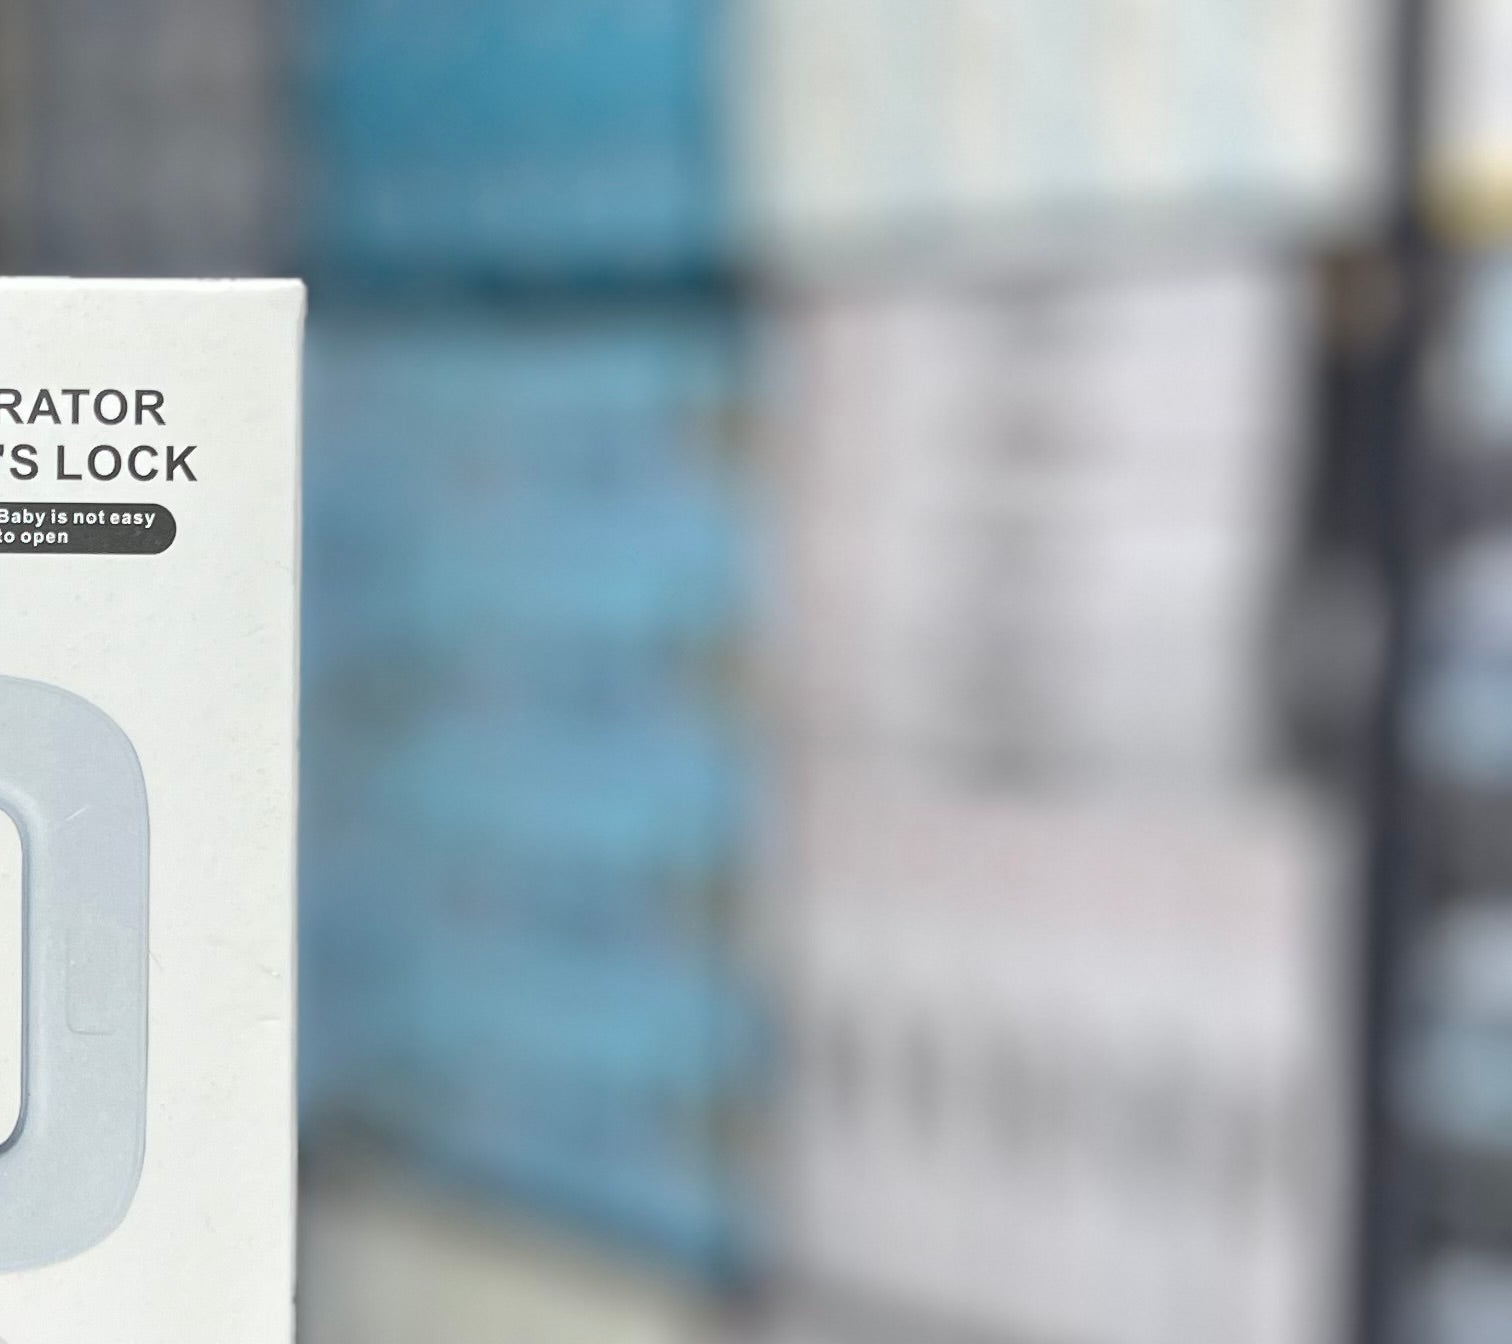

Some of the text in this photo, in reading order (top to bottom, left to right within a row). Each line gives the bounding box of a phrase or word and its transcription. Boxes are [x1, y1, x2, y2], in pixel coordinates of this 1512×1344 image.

[57, 445, 197, 481] LOCK
[50, 509, 68, 525] is
[72, 510, 106, 525] not
[109, 513, 156, 529] easy
[20, 532, 69, 547] open
